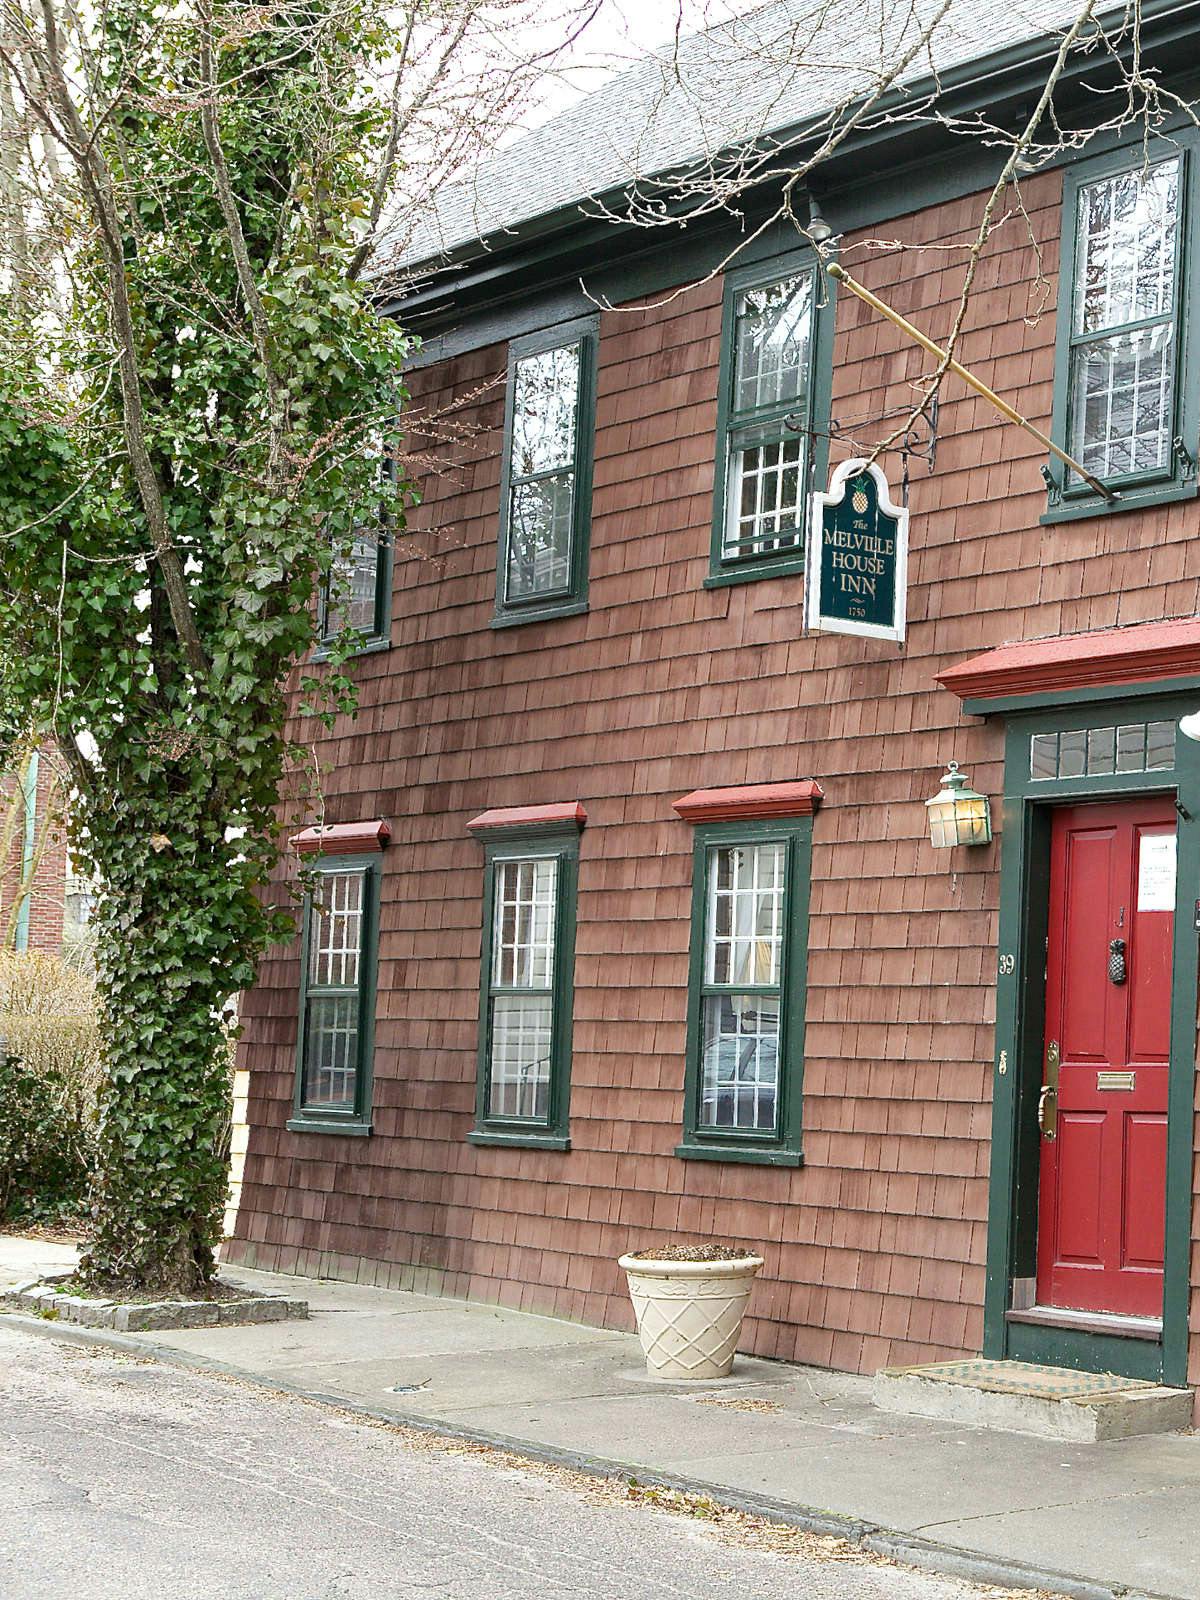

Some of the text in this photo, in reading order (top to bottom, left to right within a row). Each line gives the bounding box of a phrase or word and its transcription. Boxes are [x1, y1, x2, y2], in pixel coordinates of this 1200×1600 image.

[853, 520, 868, 529] The
[824, 528, 894, 555] MELVILLE
[832, 551, 885, 575] HOUSE
[840, 573, 876, 596] INN
[848, 607, 866, 617] 1750
[999, 954, 1014, 974] 39
